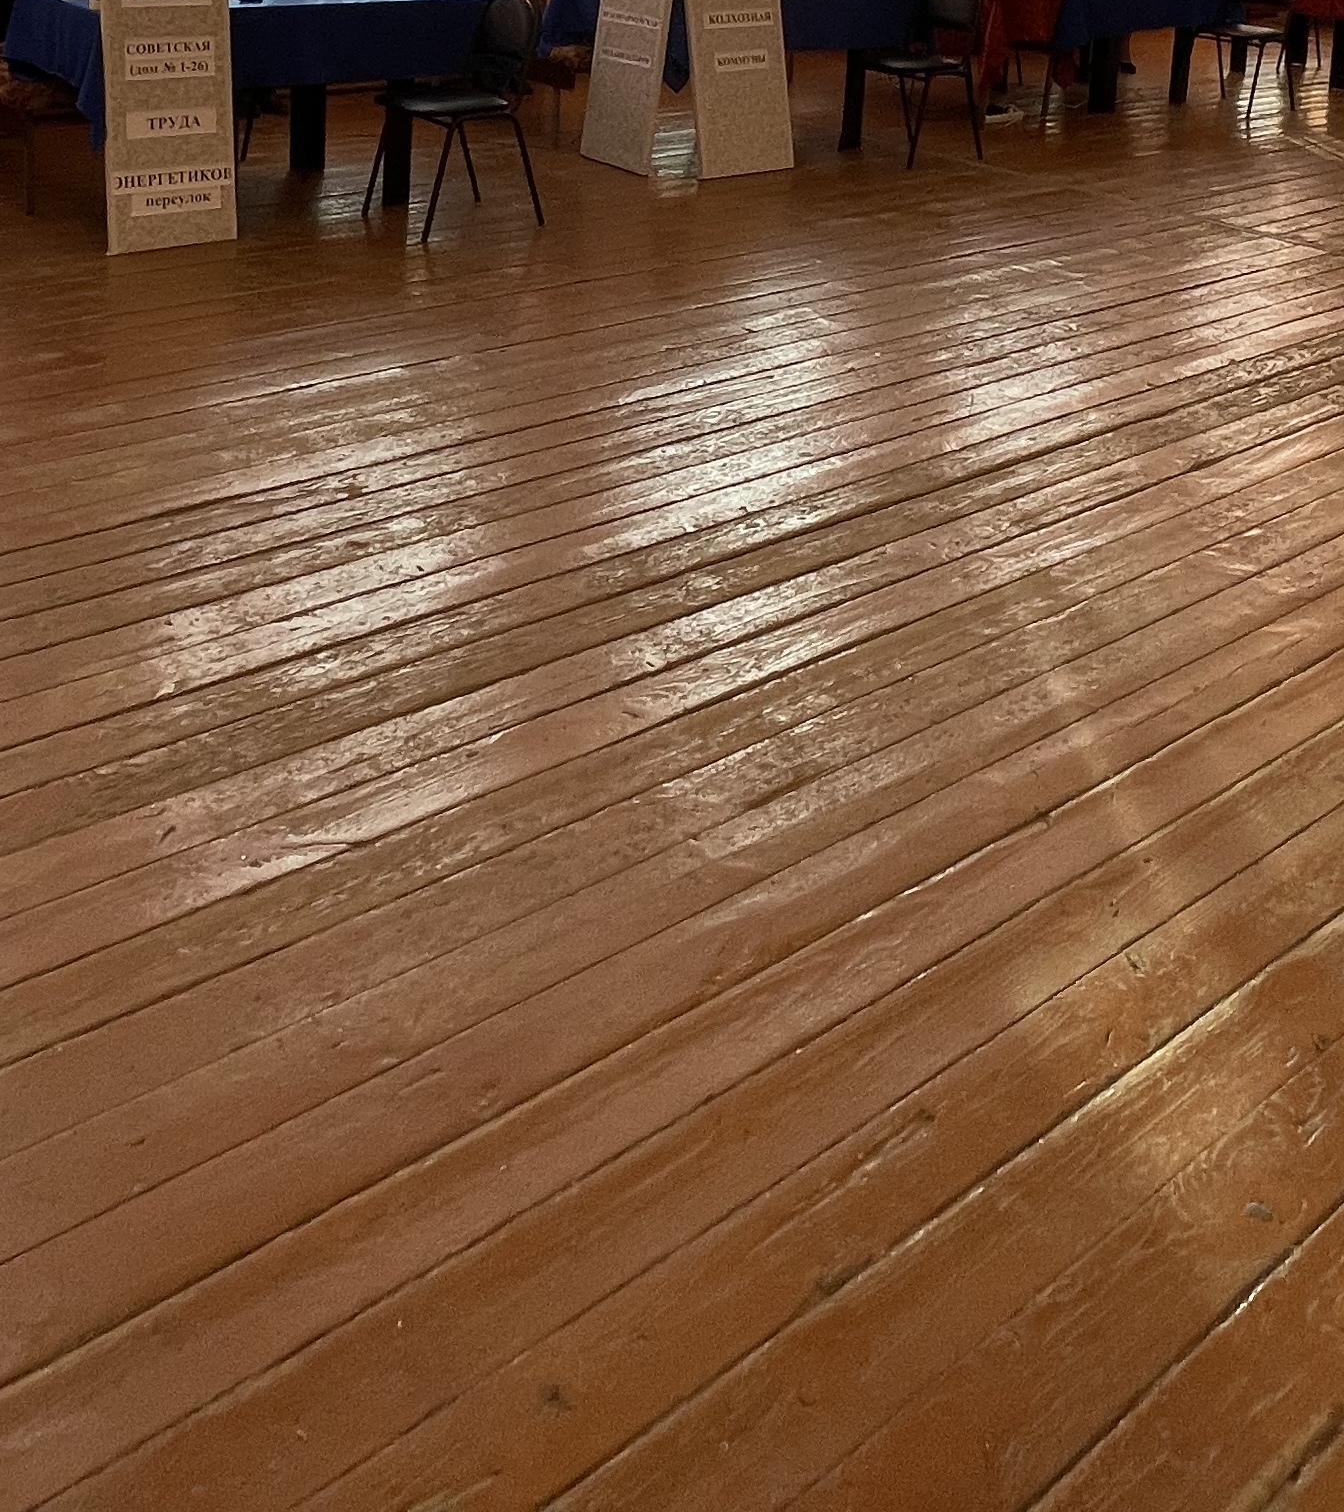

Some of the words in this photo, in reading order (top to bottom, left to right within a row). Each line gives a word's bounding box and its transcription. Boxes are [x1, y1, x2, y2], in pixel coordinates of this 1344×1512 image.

[708, 11, 772, 25] КОЛХОЗНАЯ
[126, 40, 211, 56] СОВЕТСКАЯ
[147, 114, 201, 130] ТРУДА
[145, 192, 213, 210] переулок
